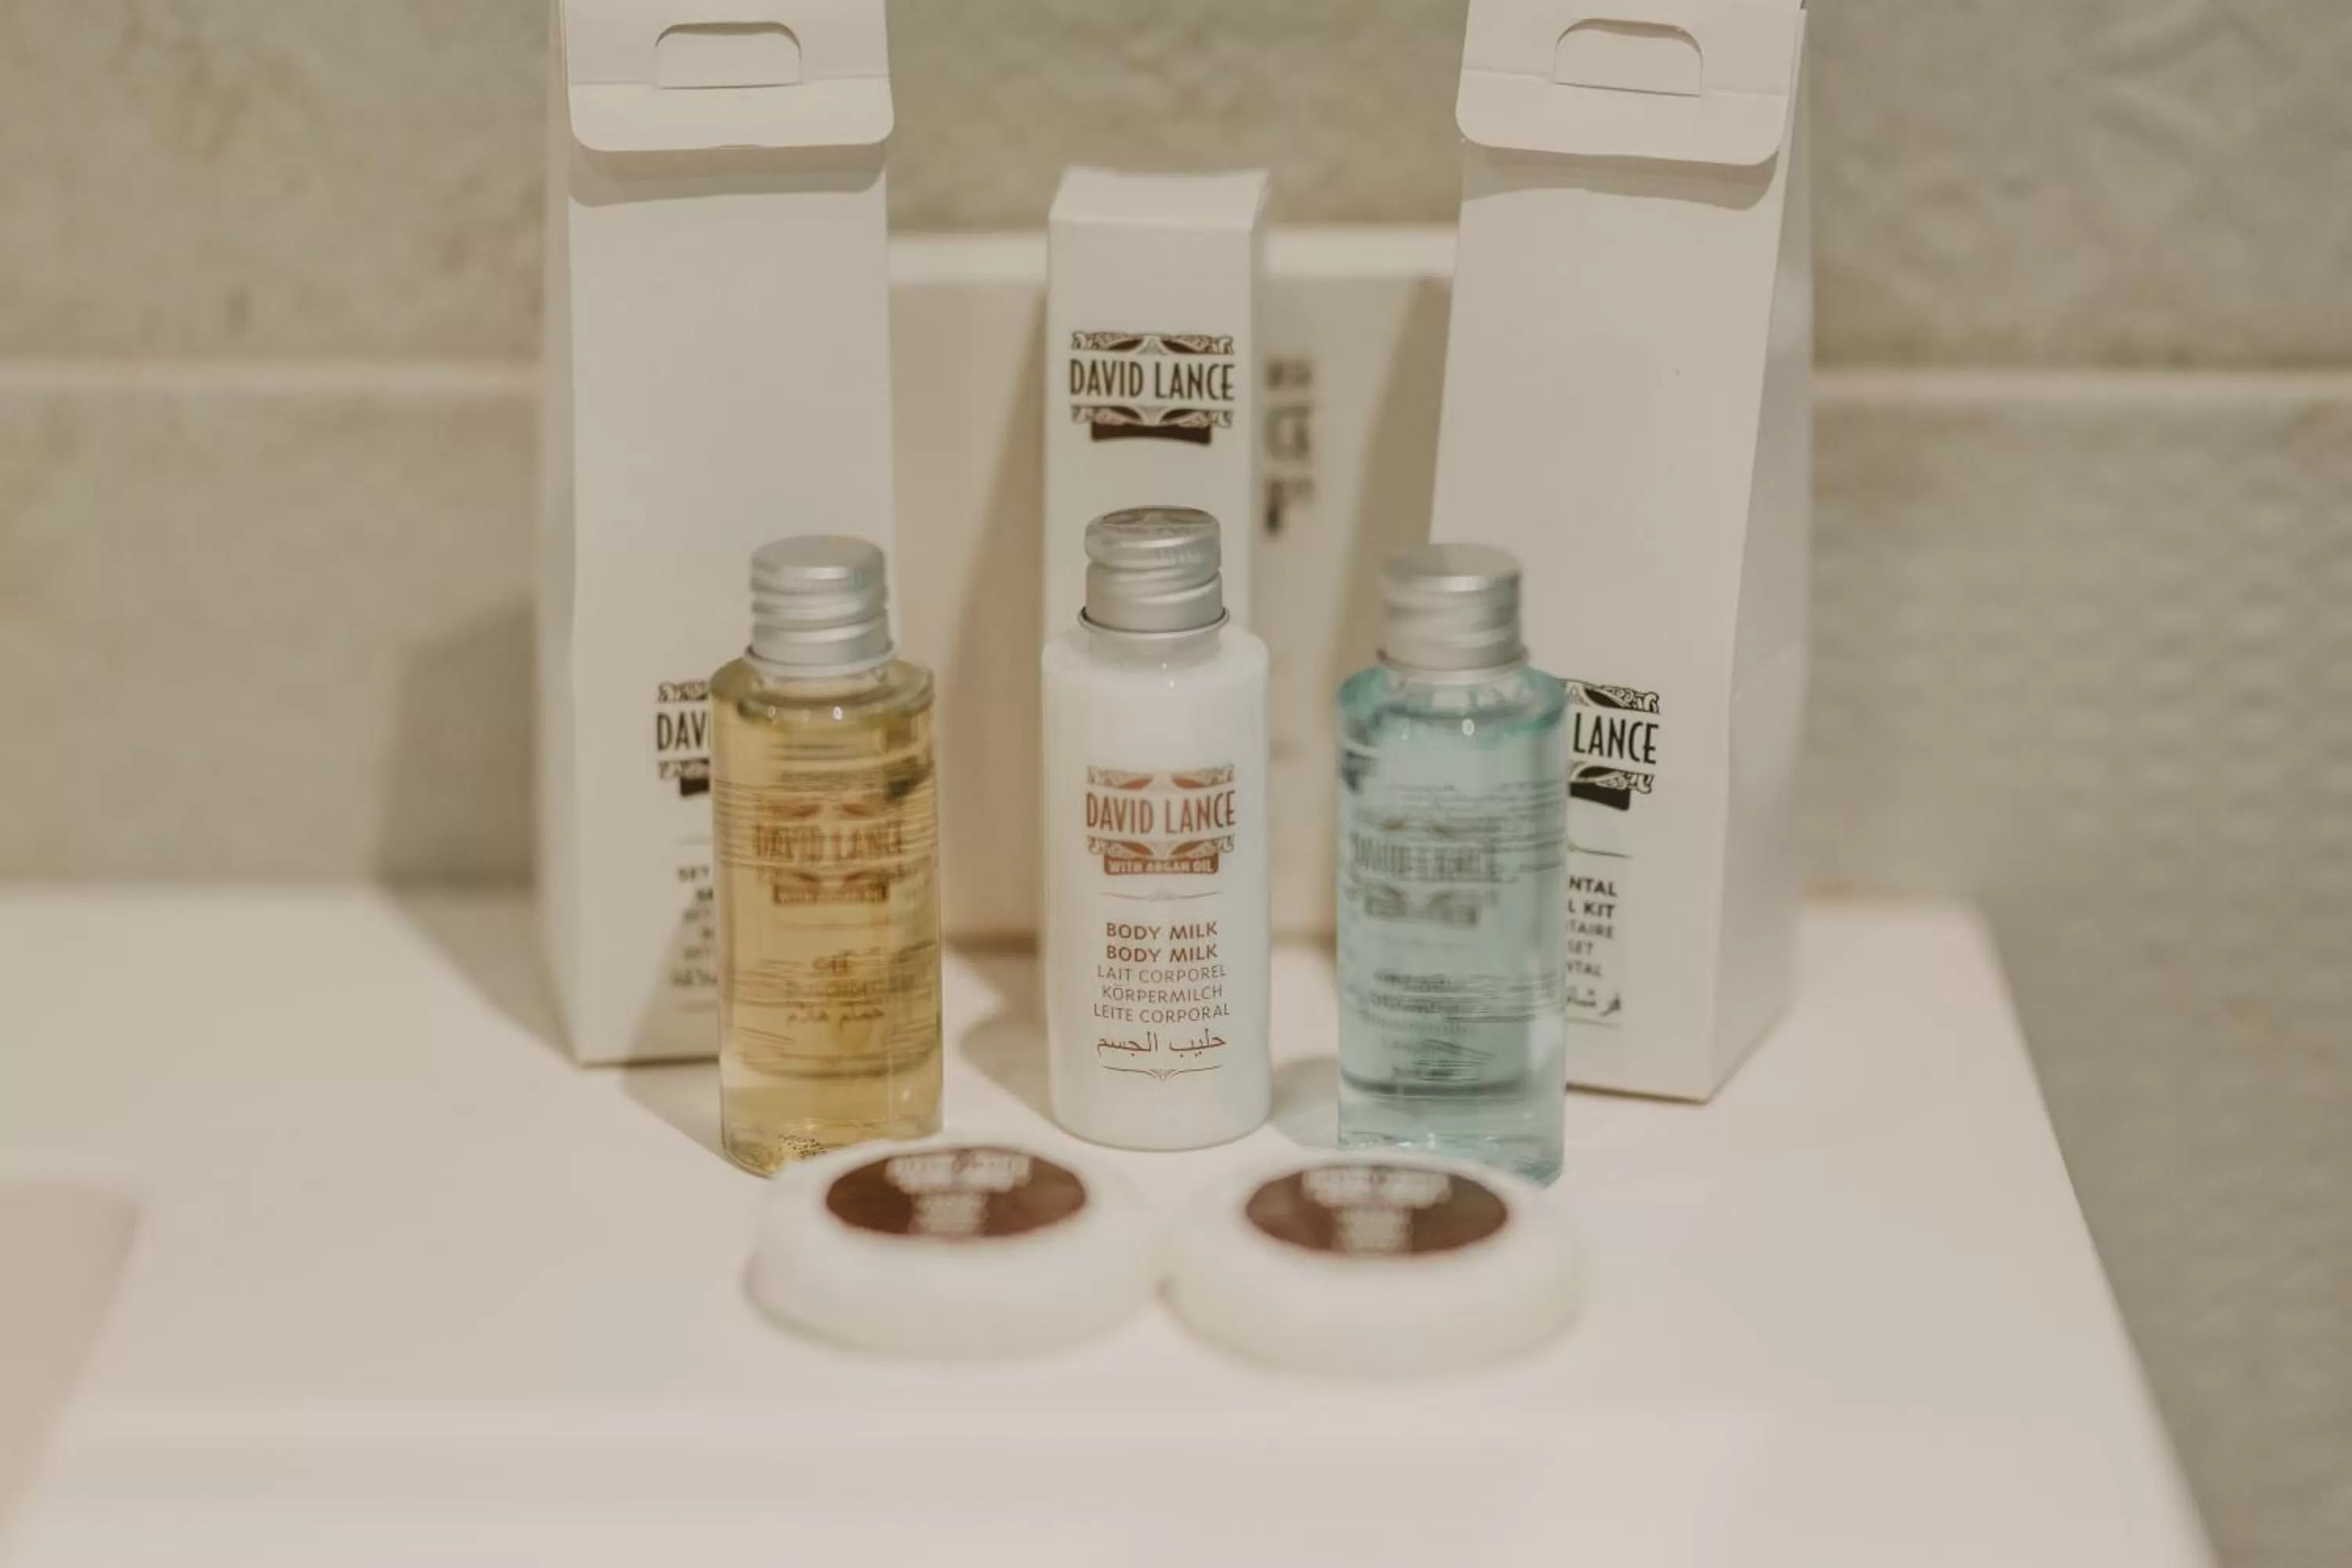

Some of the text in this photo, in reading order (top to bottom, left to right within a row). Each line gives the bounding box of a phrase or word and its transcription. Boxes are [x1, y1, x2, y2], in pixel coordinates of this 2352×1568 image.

[1070, 358, 1234, 401] DAVID LANCE
[657, 710, 708, 752] DAV
[1573, 712, 1660, 765] LANCE
[1085, 789, 1236, 835] DAVID LANCE
[1569, 875, 1619, 898] NTAL
[1583, 901, 1616, 920] KIT
[1105, 920, 1218, 941] BODY MILK
[1569, 919, 1614, 939] TAIRE
[1105, 943, 1218, 963] BODY MILK
[1097, 964, 1227, 984] LAIT CORPOREL
[1102, 983, 1223, 1004] KÖRPERMILCH
[1093, 1003, 1230, 1023] LEITE CORPORAL
[1097, 1028, 1227, 1058] حليب الجسم
